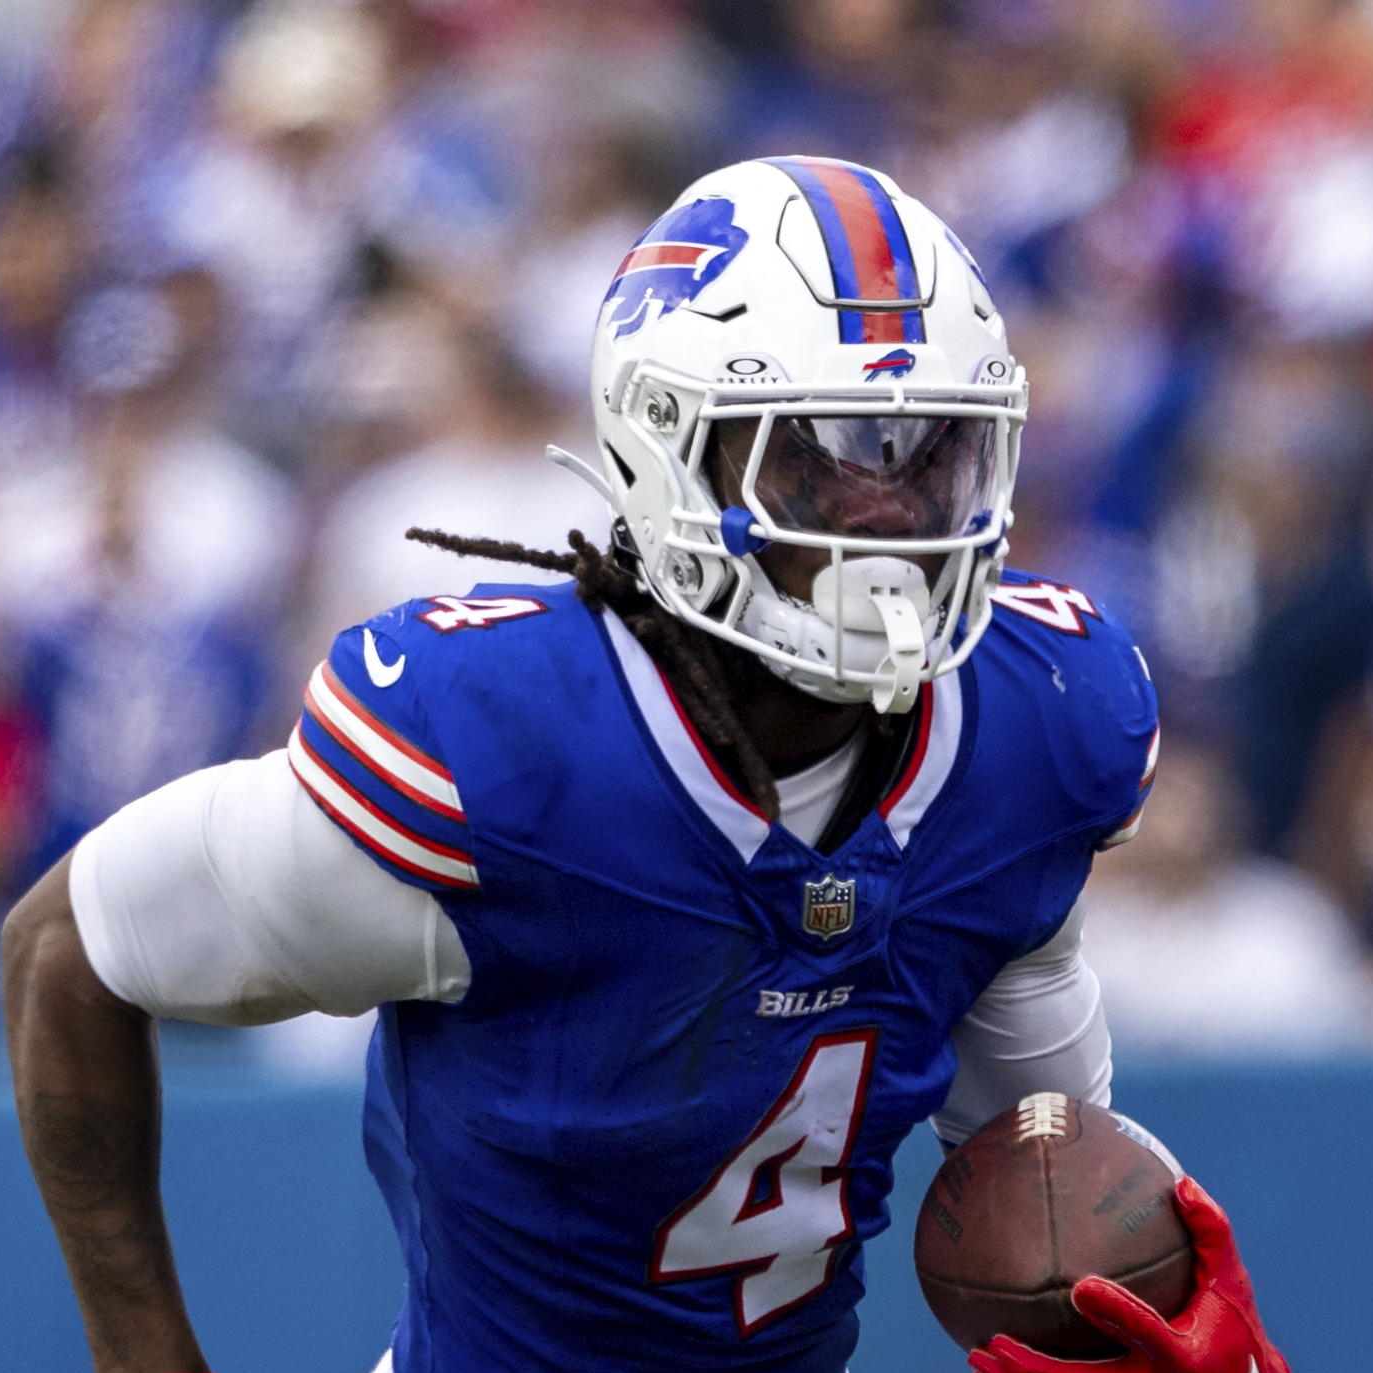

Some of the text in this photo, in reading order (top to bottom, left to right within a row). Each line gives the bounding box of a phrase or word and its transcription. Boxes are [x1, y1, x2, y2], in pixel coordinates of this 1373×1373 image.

[417, 595, 548, 635] 4
[989, 580, 1103, 638] 4
[811, 904, 847, 929] NFL
[756, 986, 854, 1017] BILLS
[647, 1027, 878, 1339] 4
